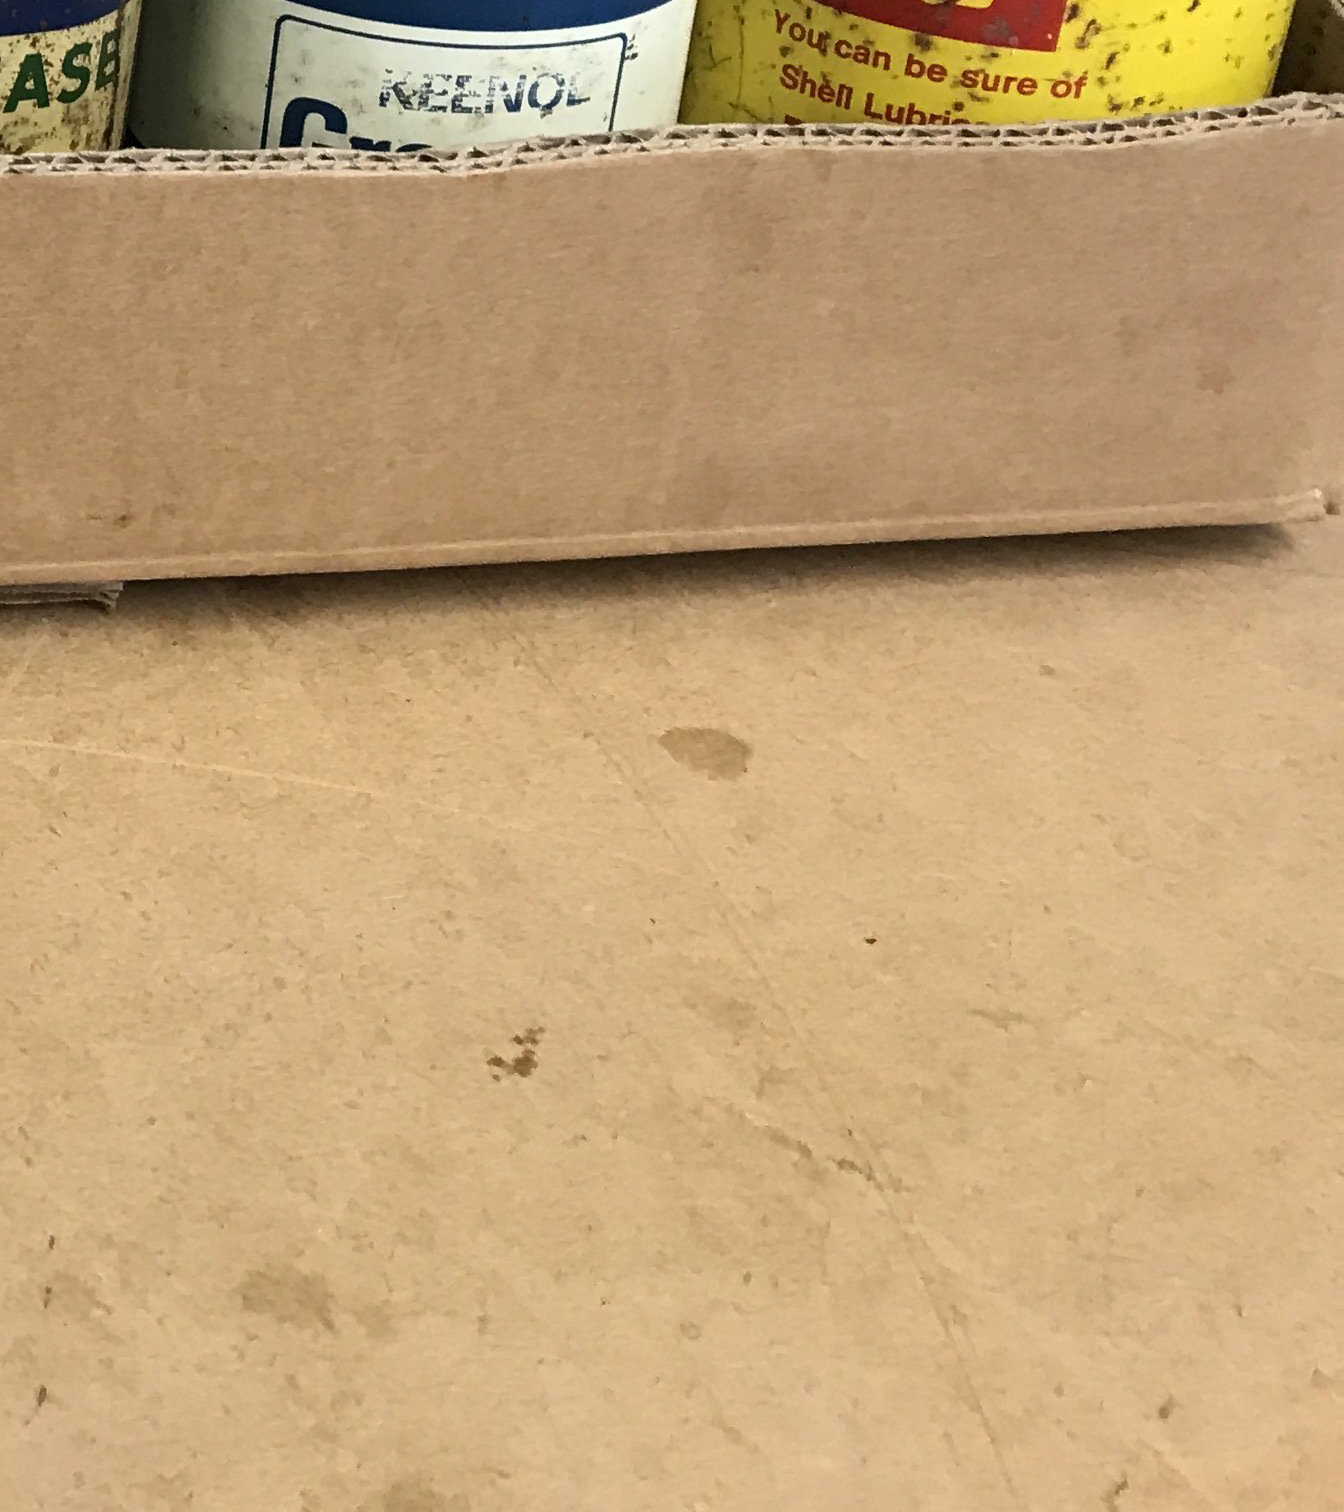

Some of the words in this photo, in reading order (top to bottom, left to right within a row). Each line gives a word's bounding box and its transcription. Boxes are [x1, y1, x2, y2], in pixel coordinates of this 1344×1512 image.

[773, 8, 829, 51] You
[834, 37, 892, 71] can
[904, 53, 949, 84] be
[960, 68, 1039, 97] sure
[1050, 72, 1089, 100] of
[378, 70, 592, 116] KEENOL
[779, 63, 854, 110] Shell
